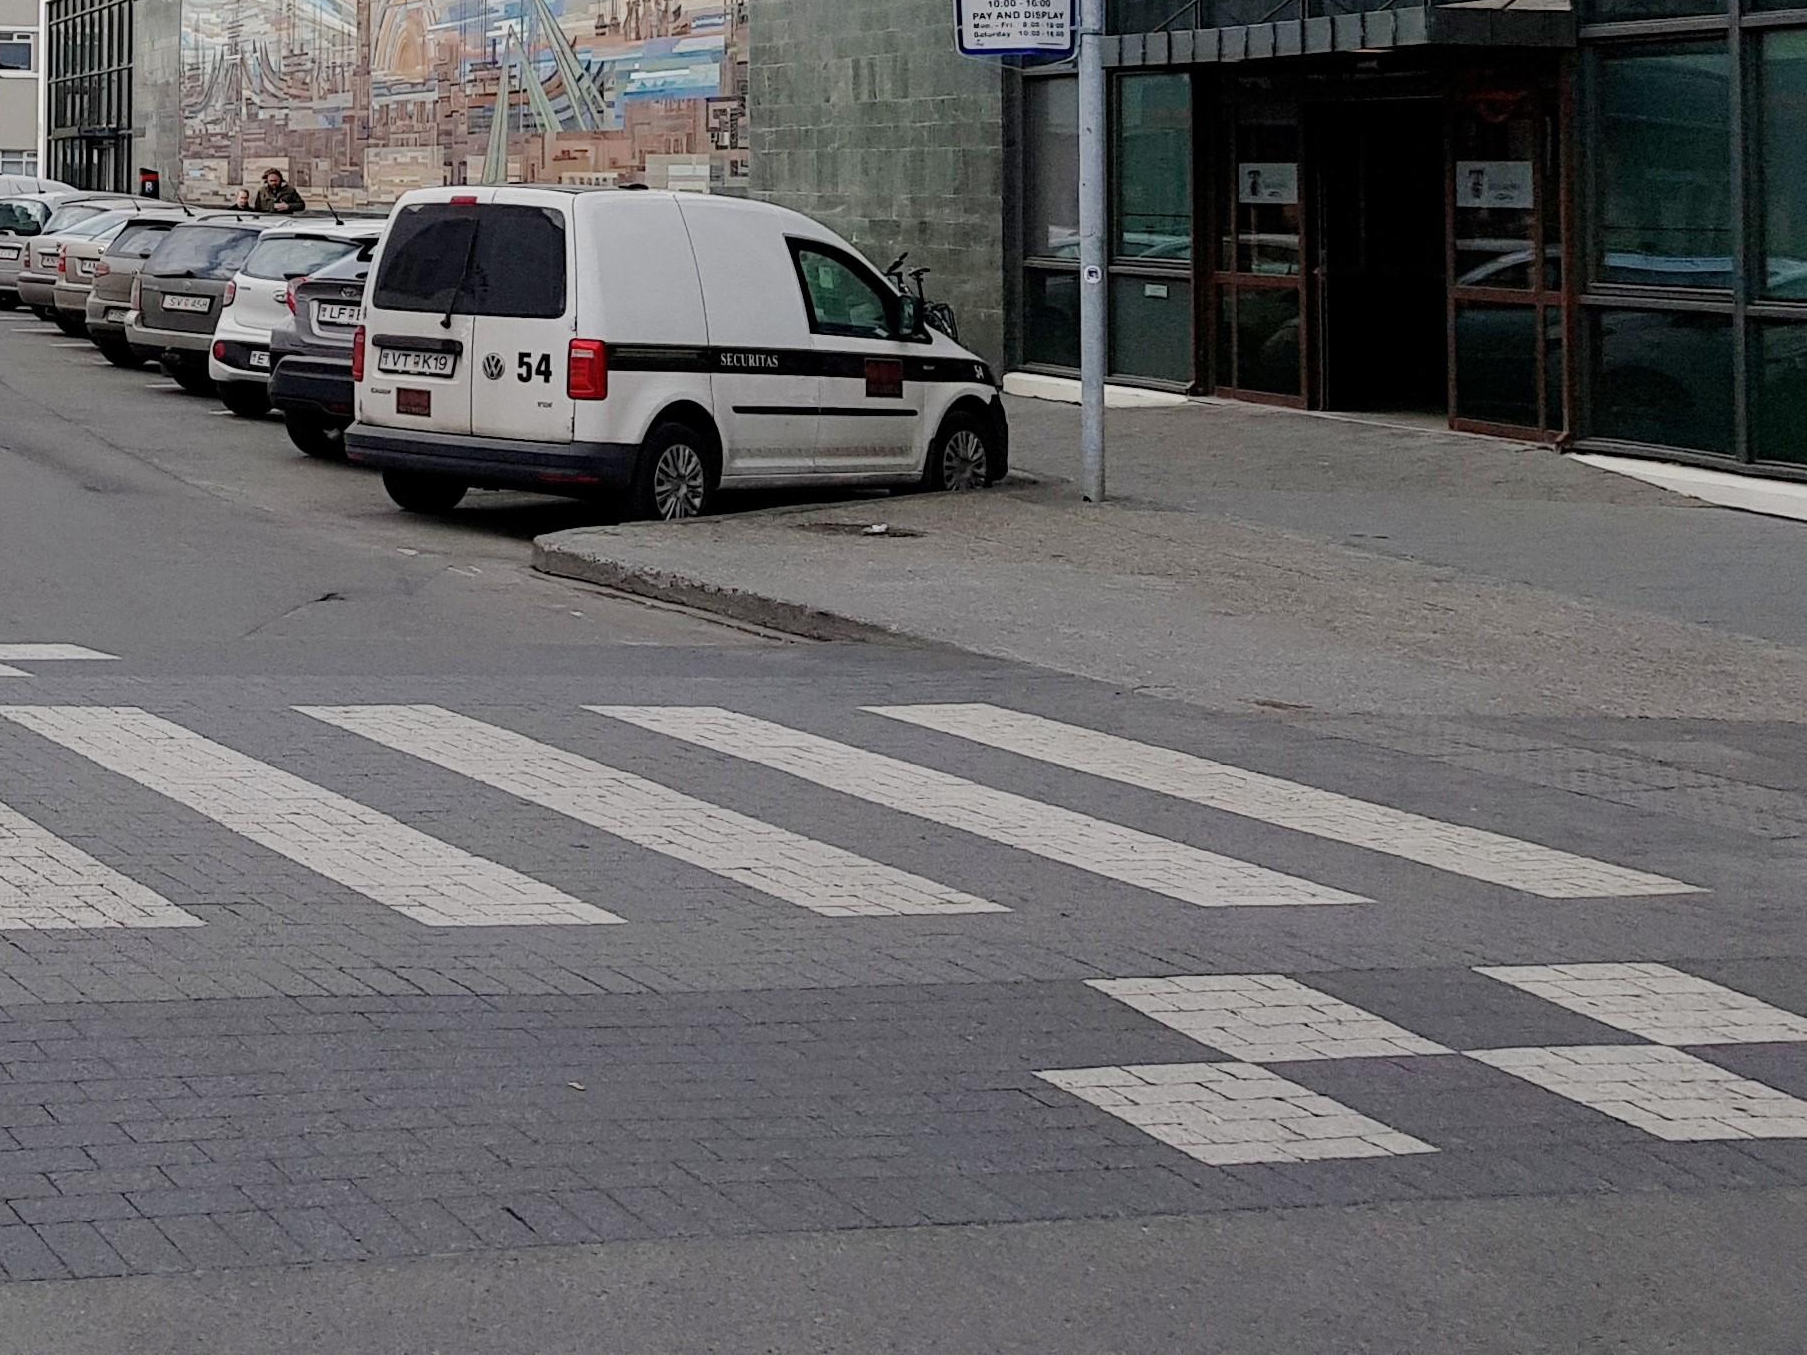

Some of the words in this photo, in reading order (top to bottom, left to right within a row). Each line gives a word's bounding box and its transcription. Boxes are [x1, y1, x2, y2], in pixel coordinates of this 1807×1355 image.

[972, 12, 993, 20] PAY
[996, 11, 1020, 20] AND
[1024, 11, 1064, 20] DISPLAY
[392, 351, 411, 367] VT
[422, 354, 448, 371] K19
[517, 352, 552, 383] 54
[720, 352, 779, 367] SECURITAS
